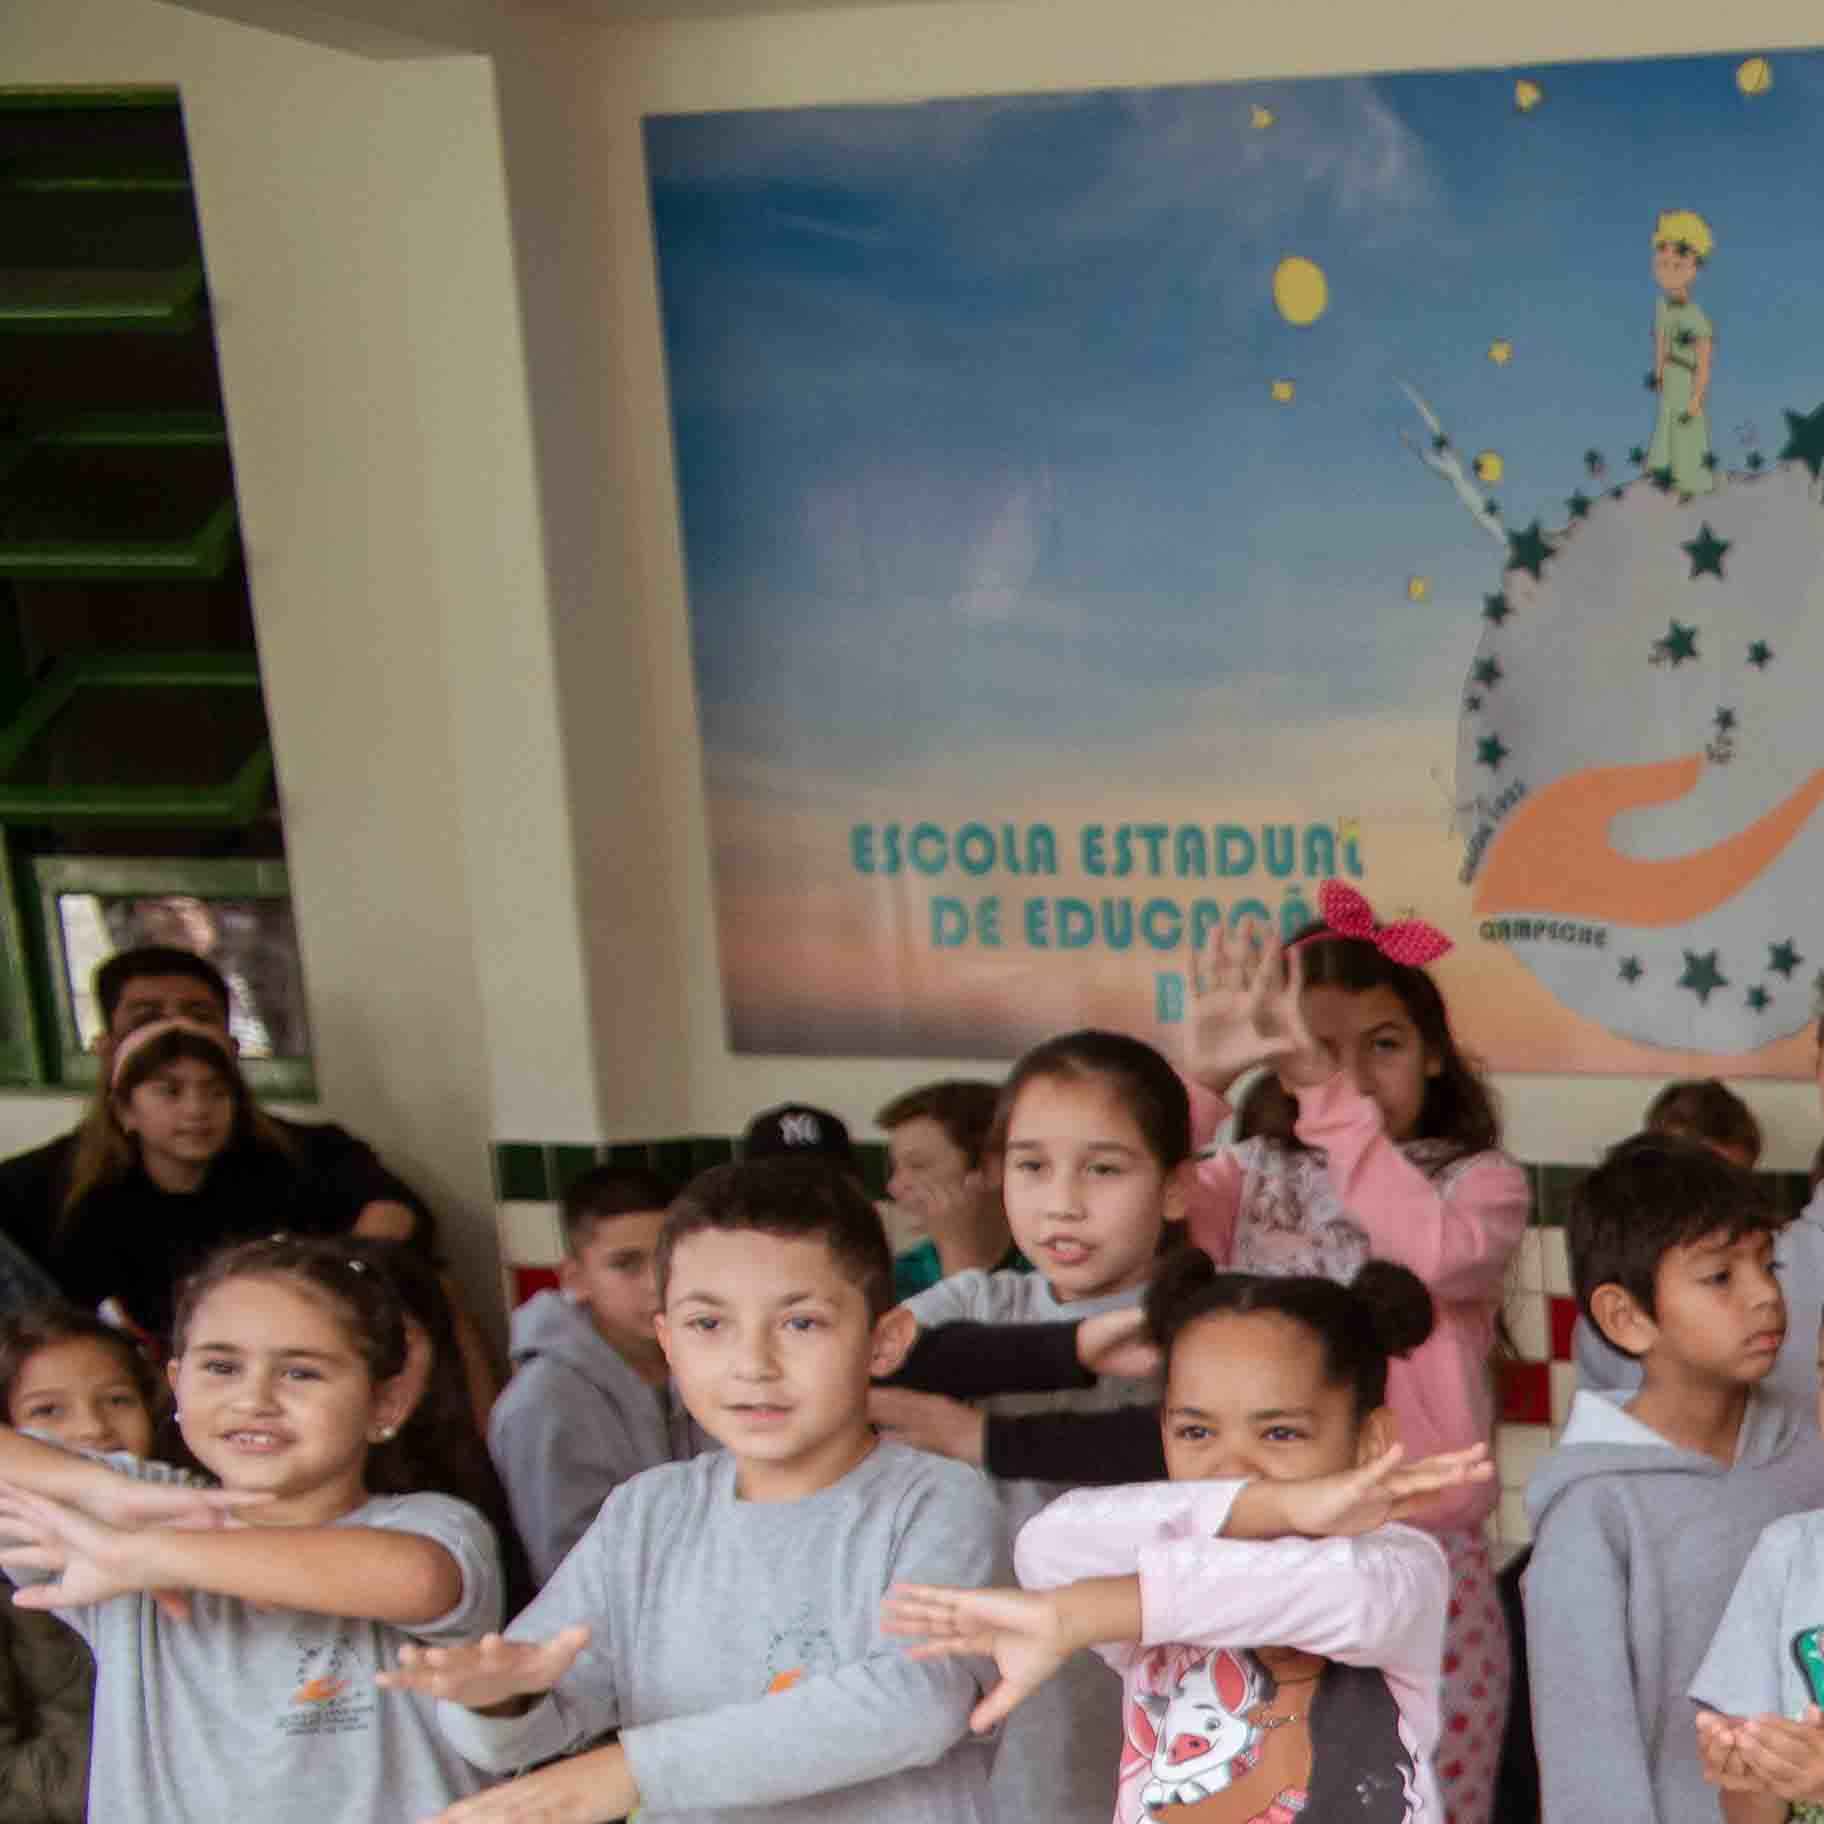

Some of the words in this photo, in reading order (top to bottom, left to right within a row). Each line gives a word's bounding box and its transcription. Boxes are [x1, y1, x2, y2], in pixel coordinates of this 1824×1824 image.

[848, 822, 1060, 879] ESCOLA
[1081, 822, 1365, 880] ESTADUAL
[930, 896, 1002, 949] DE
